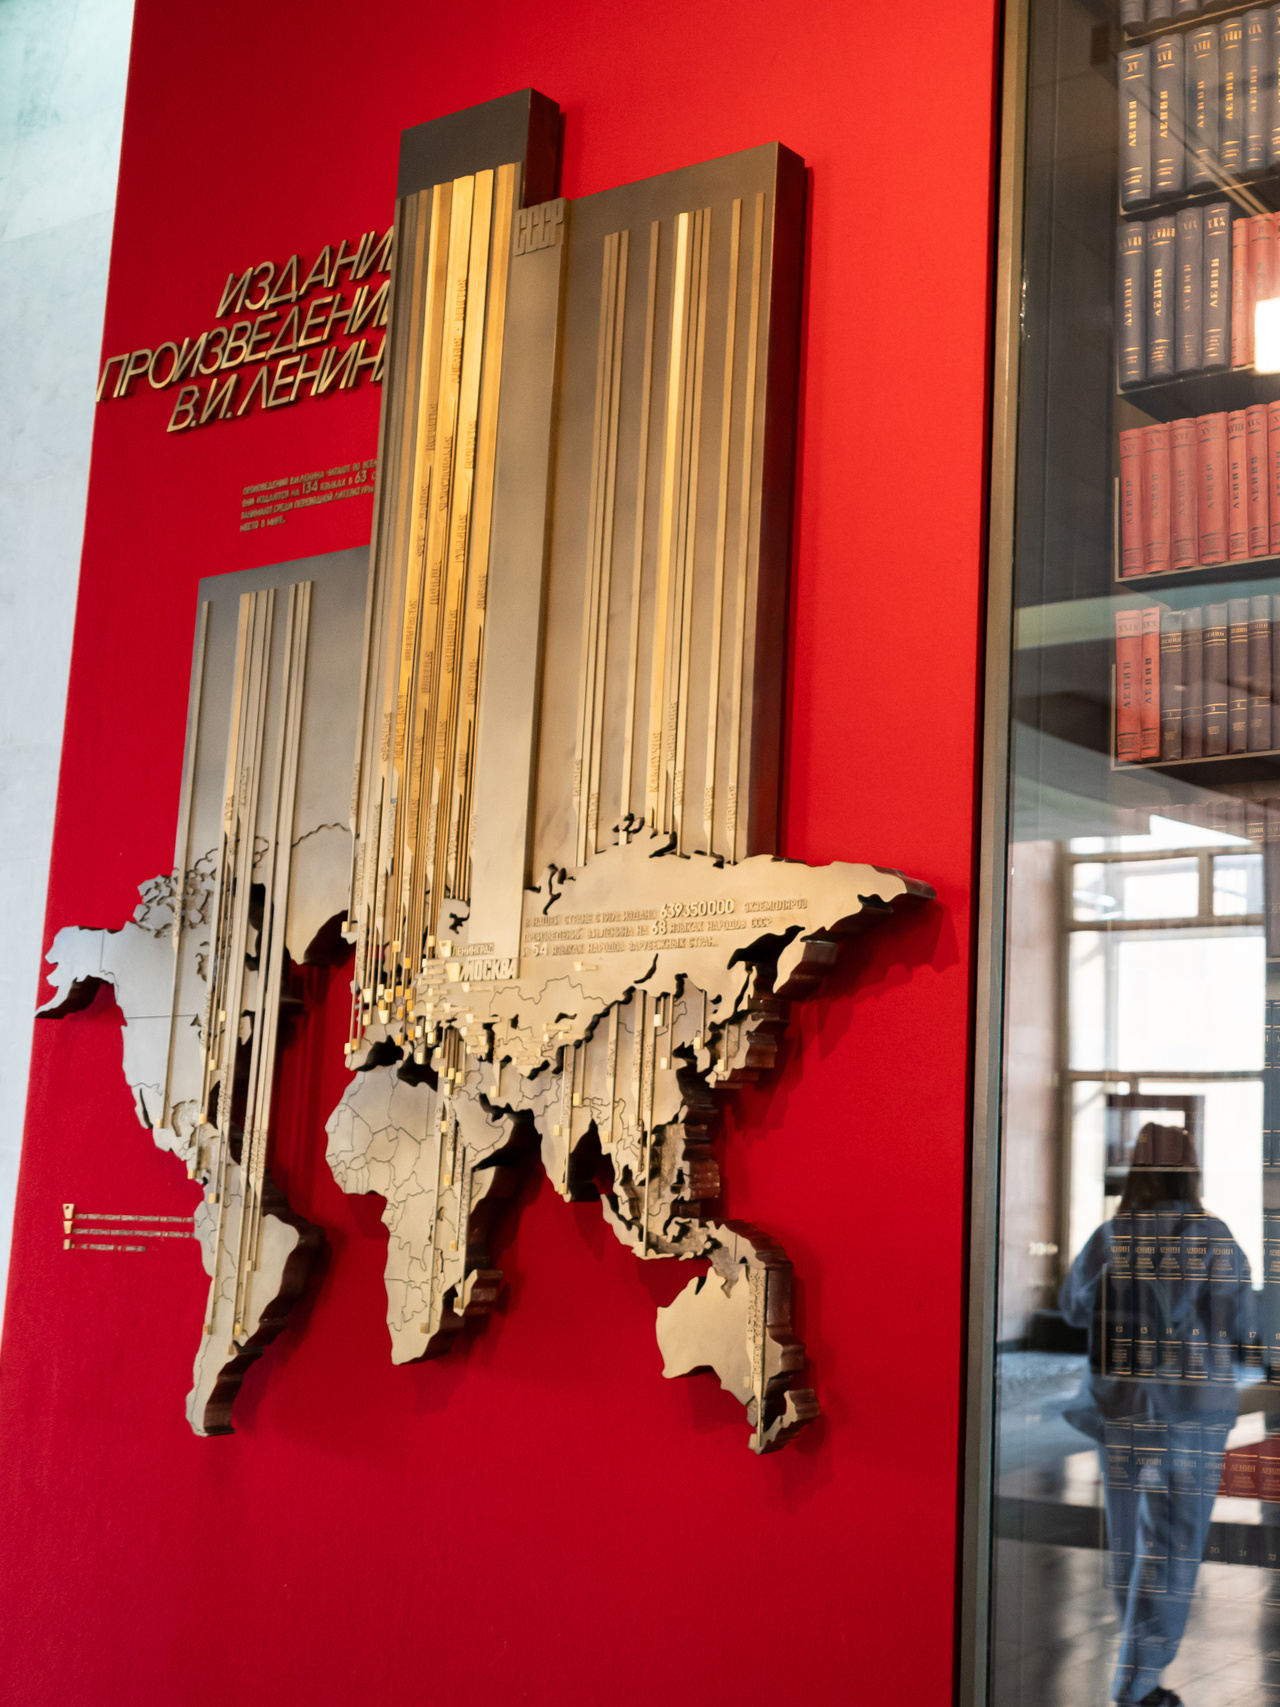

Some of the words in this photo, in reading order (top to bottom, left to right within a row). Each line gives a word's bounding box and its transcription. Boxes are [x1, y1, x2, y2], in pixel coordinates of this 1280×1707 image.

[513, 200, 563, 257] СССР
[215, 225, 394, 318] ИЗДАНИ
[96, 279, 391, 402] ПРОИЗВЕДЕНИ
[237, 335, 386, 416] ЛЕНИН
[302, 481, 318, 494] 134
[355, 470, 367, 483] 63
[660, 898, 735, 919] 639350000
[744, 898, 808, 913] ЭКЗЕМПЛЯРОВ
[650, 919, 668, 936] 68
[670, 921, 704, 934] ЯЗЫКАХ
[708, 919, 746, 931] НАРОДОВ
[451, 943, 495, 957] ЛЕНИНГРАД
[531, 942, 548, 957] 54
[460, 957, 518, 981] МОСКВА
